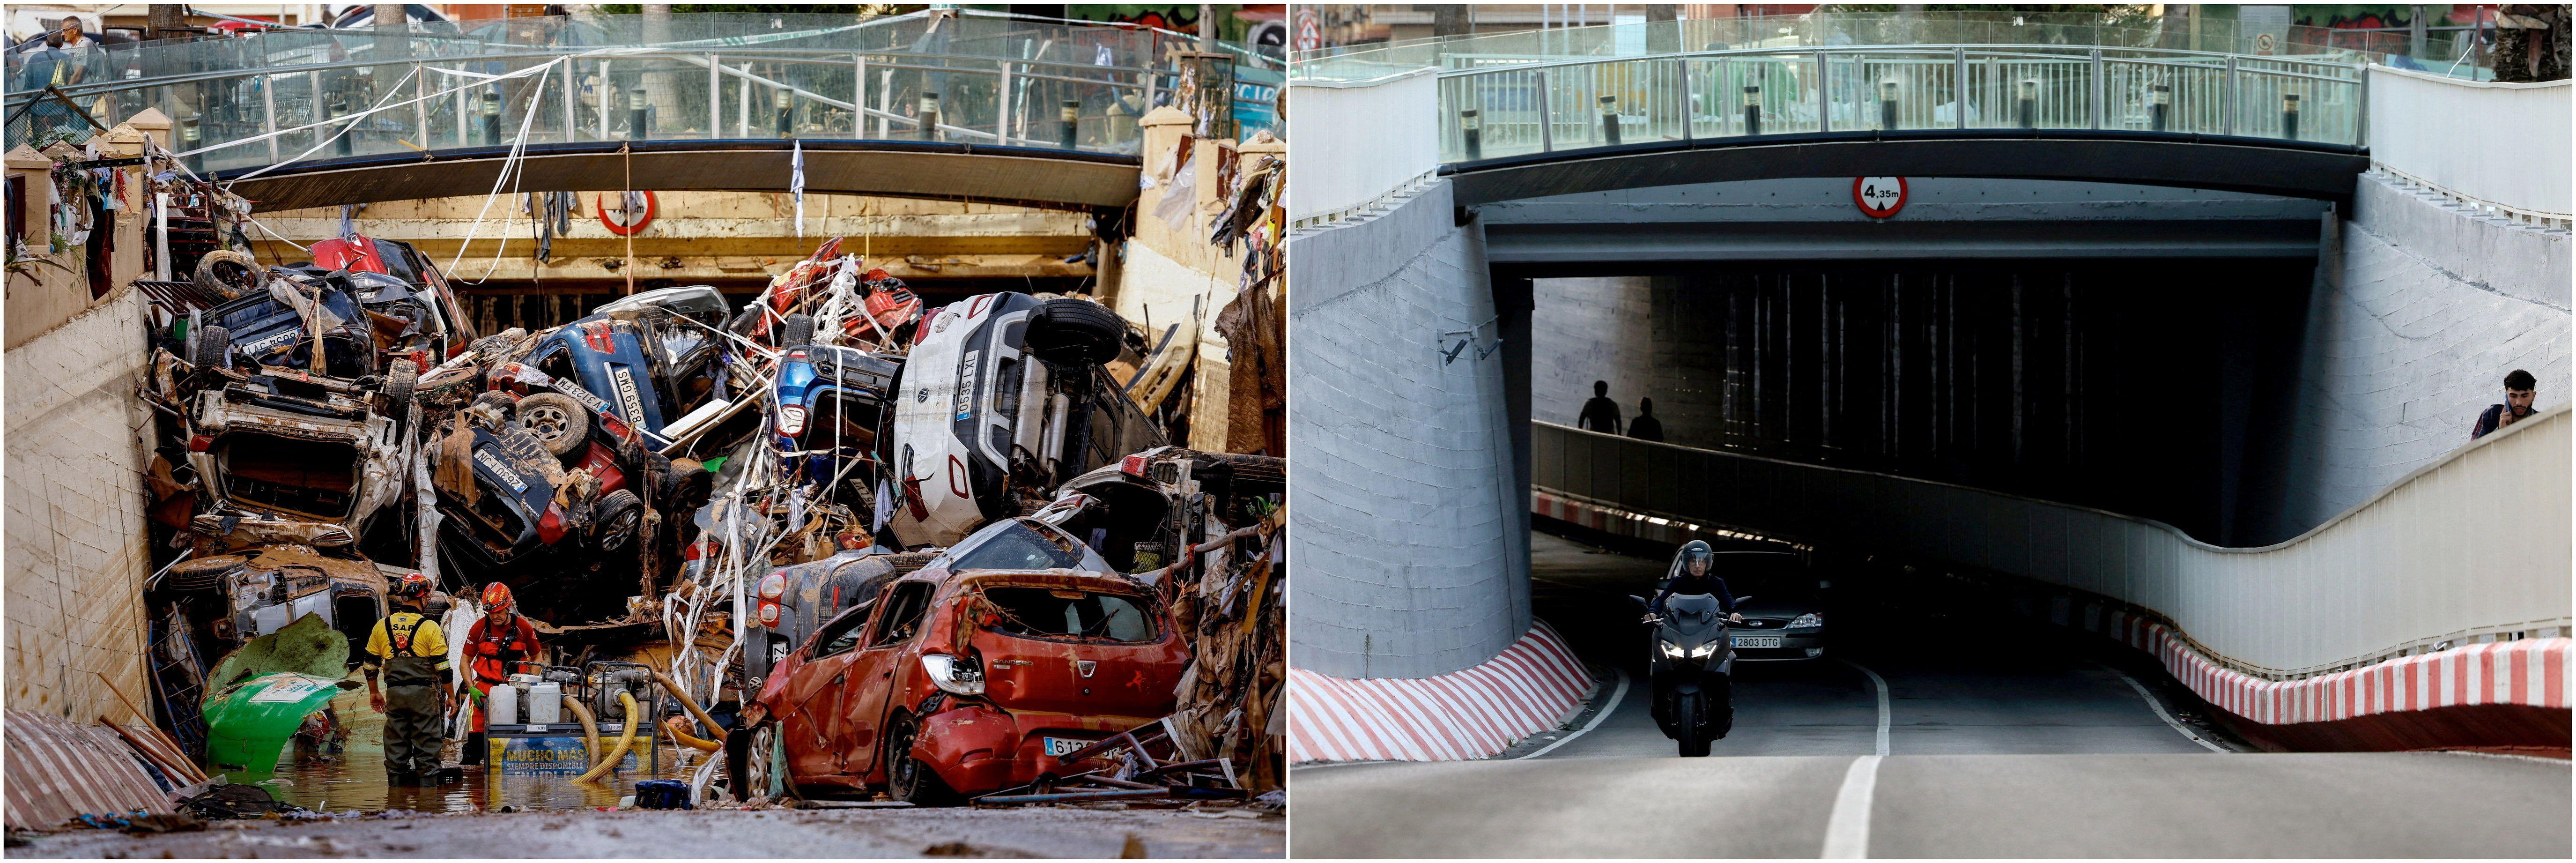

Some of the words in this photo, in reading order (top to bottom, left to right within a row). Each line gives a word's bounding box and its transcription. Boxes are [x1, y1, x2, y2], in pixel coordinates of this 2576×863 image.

[1865, 185, 1899, 199] 4,35m
[963, 354, 976, 378] LXL
[618, 372, 632, 393] GMS
[572, 387, 595, 404] 3123
[959, 381, 971, 412] 0535
[625, 394, 642, 423] 8359
[496, 467, 520, 488] 2630
[506, 749, 554, 761] MUCHO
[558, 747, 585, 761] MÁS
